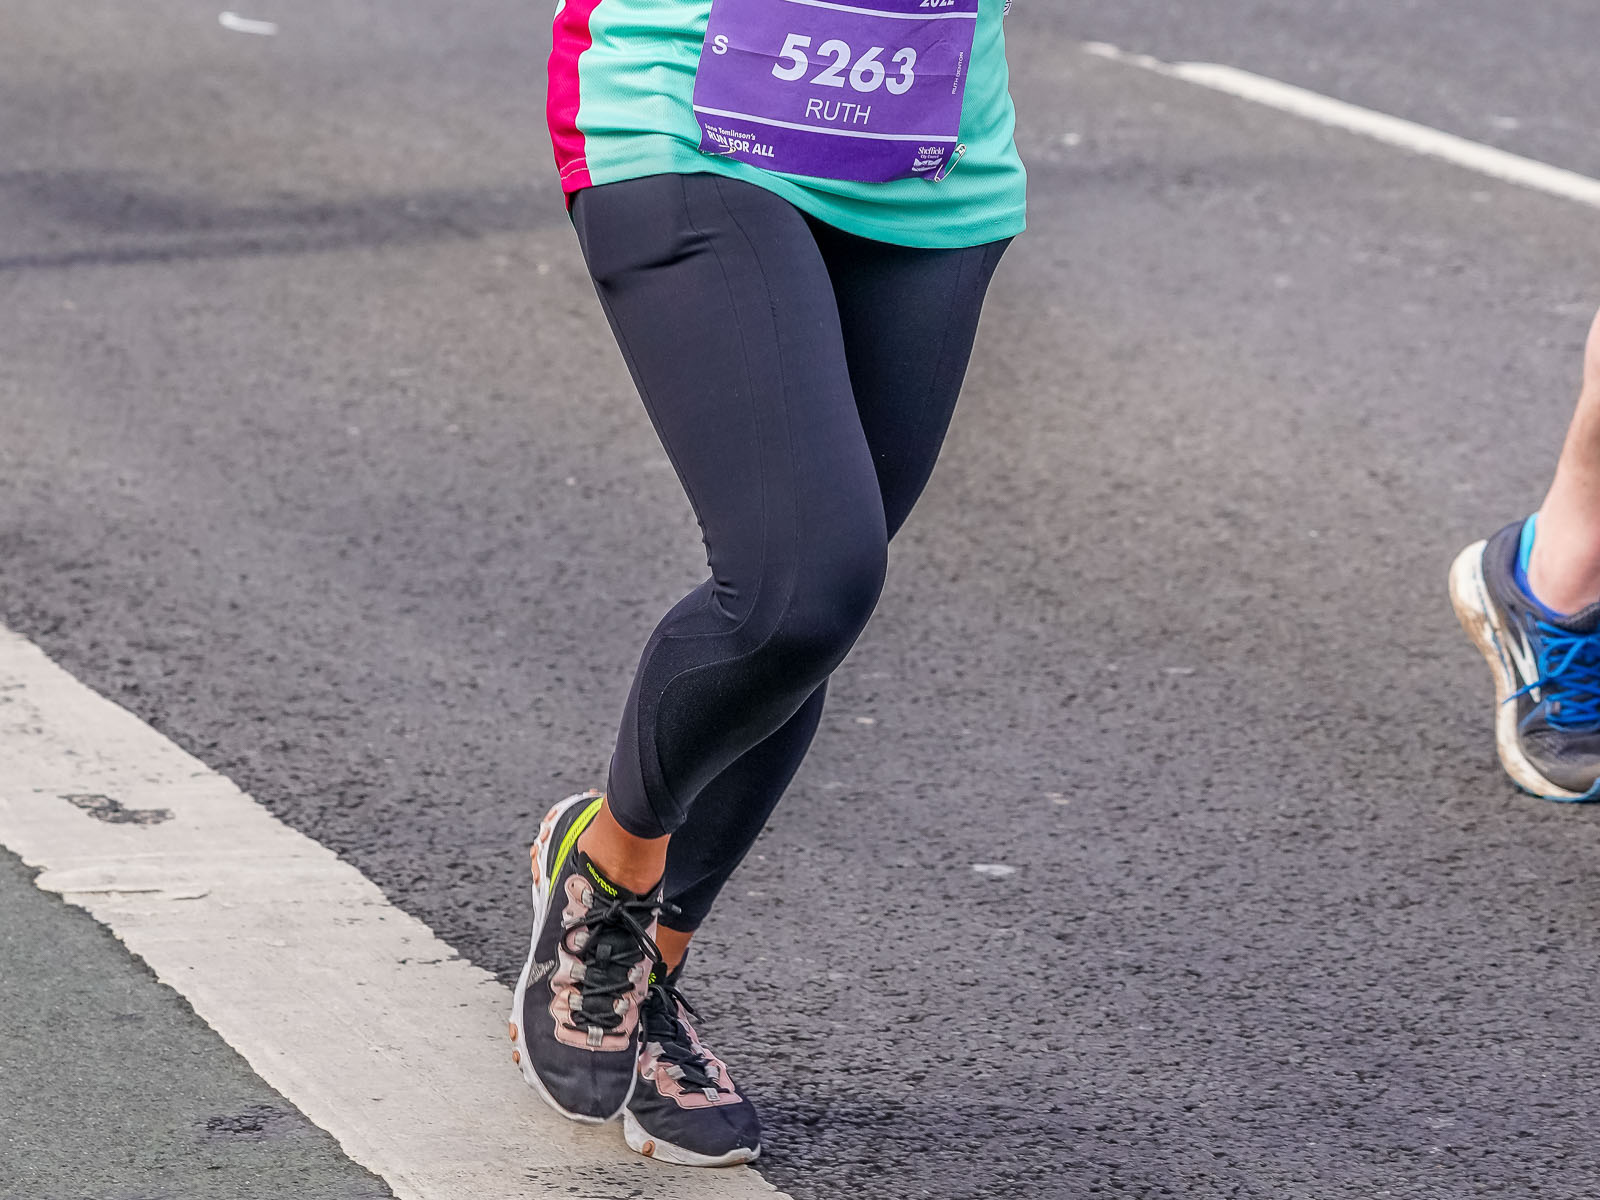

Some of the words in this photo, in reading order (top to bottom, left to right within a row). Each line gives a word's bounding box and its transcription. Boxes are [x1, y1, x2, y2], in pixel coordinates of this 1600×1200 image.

[711, 34, 729, 55] S
[771, 32, 917, 95] 5263
[804, 97, 872, 125] RUTH
[706, 129, 729, 146] RUN
[728, 137, 750, 153] FOR
[751, 142, 775, 158] ALL
